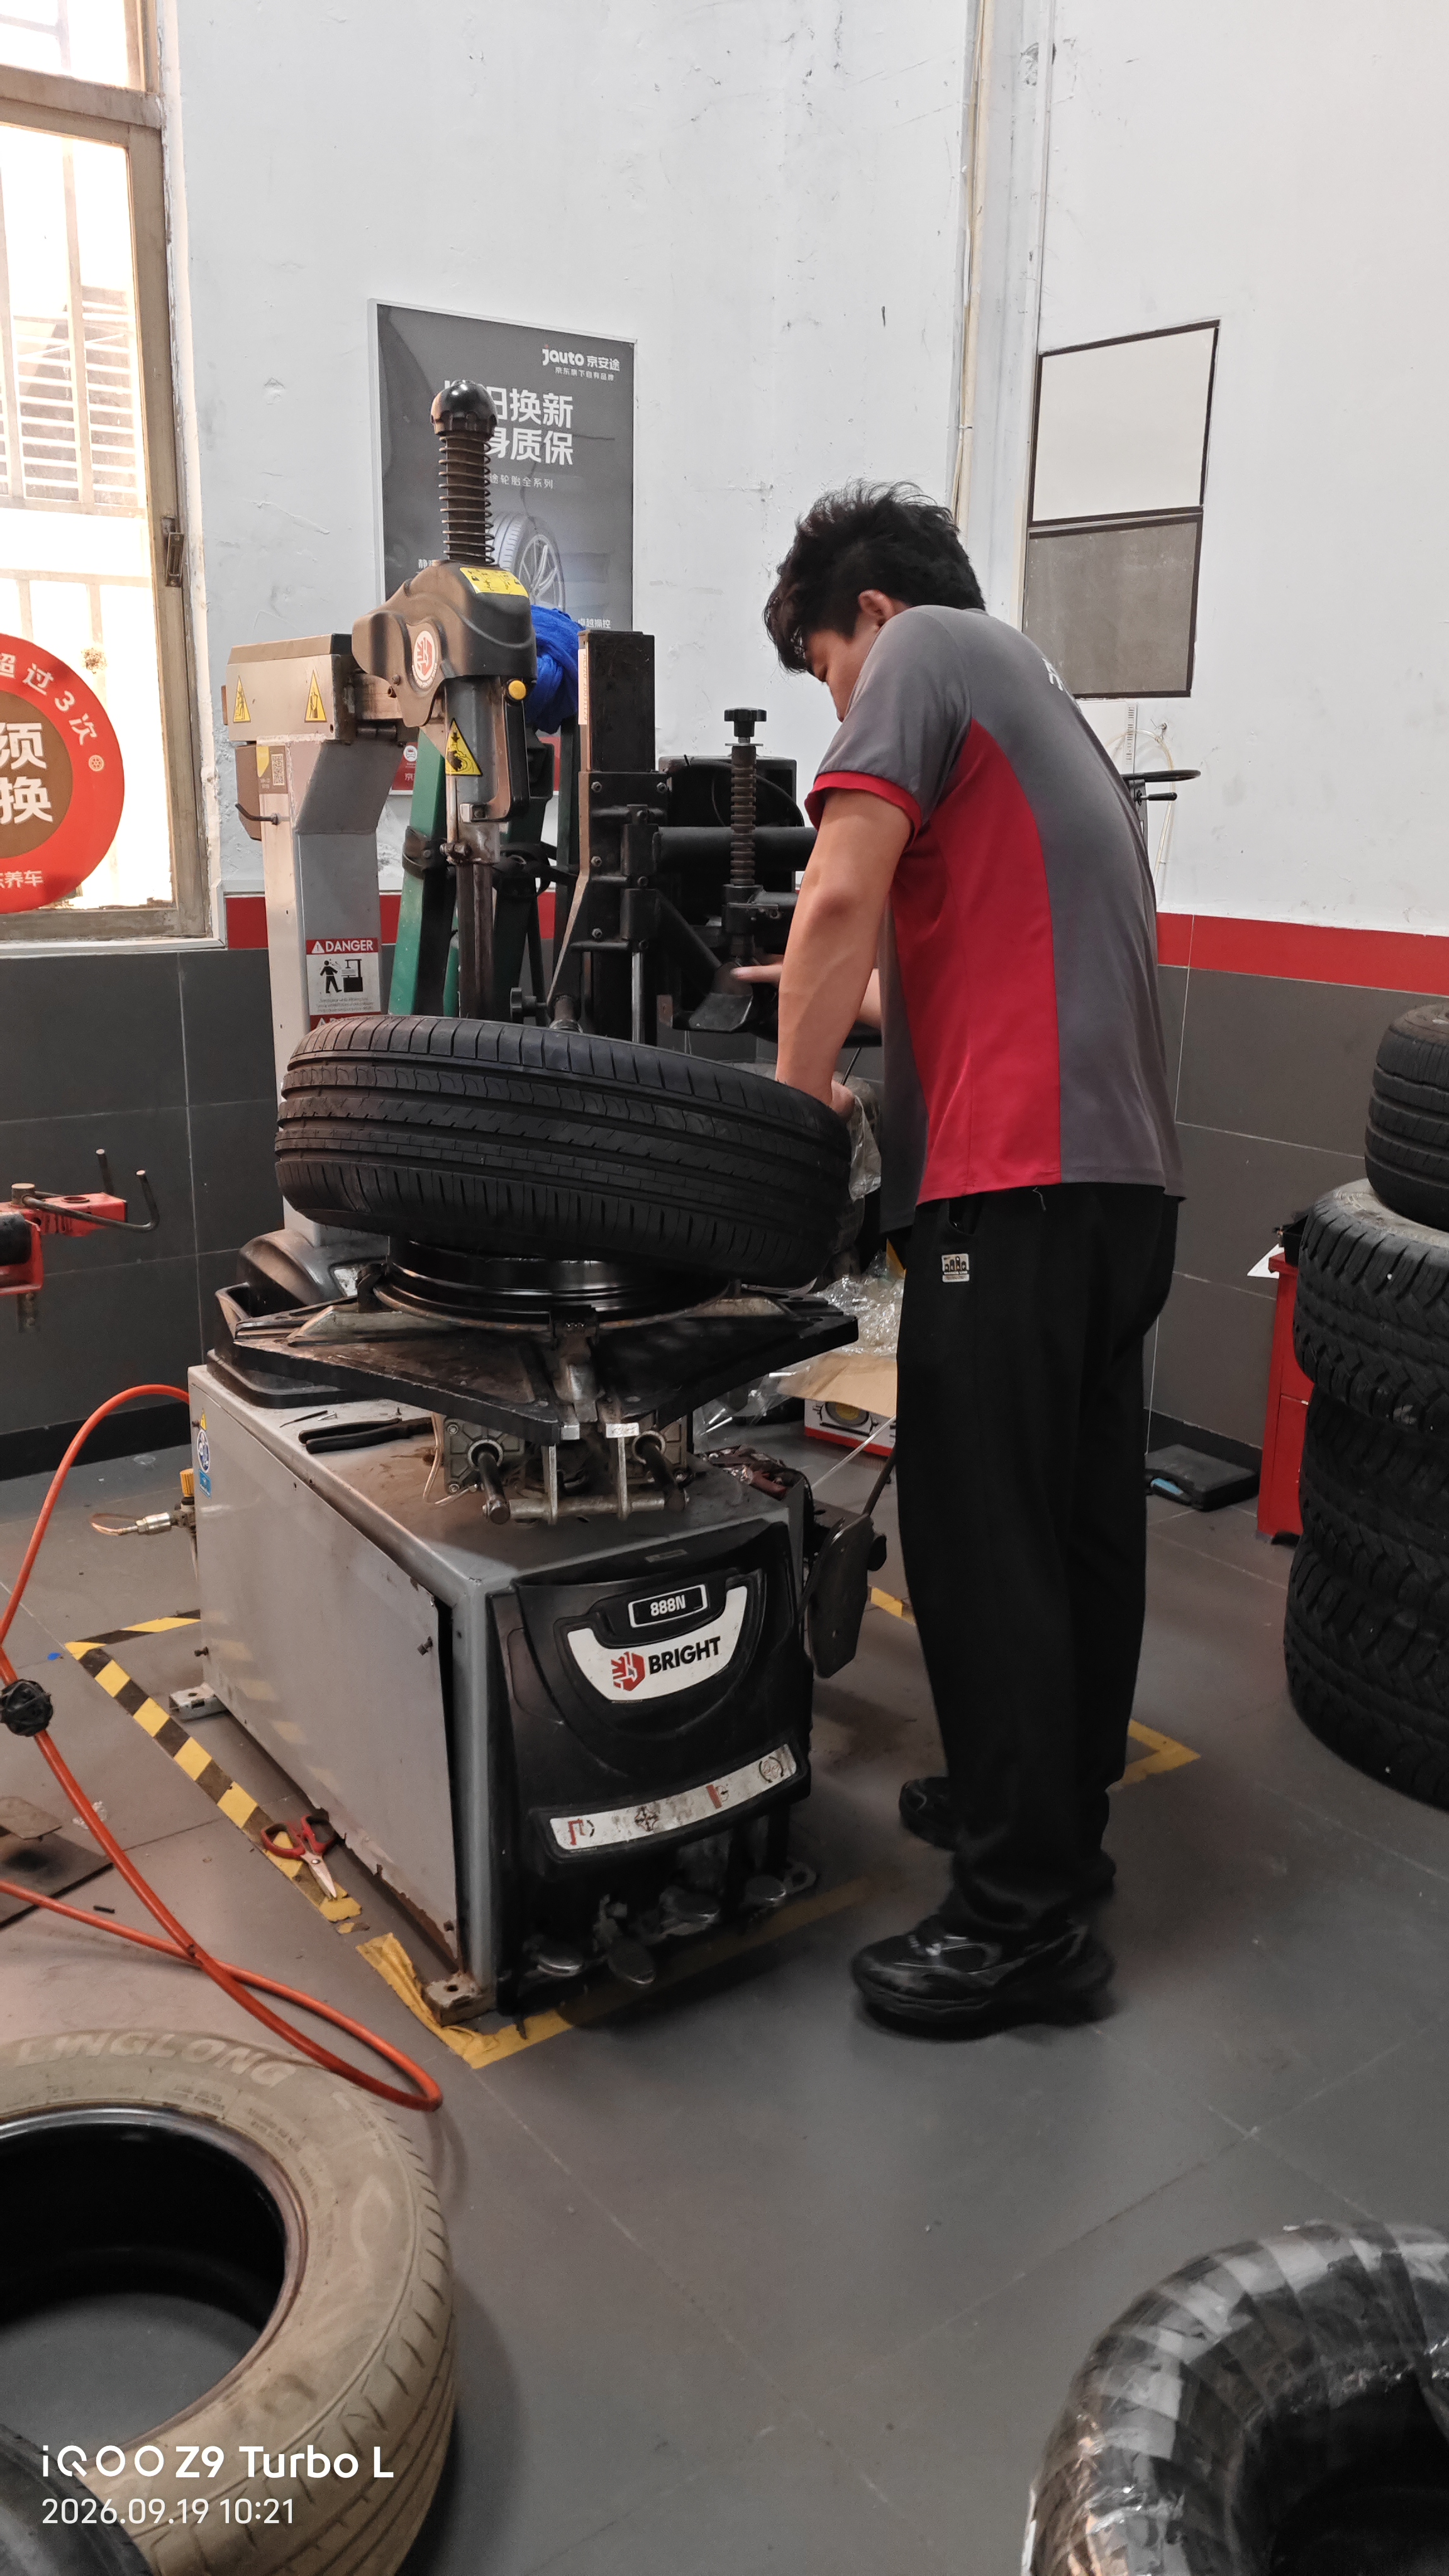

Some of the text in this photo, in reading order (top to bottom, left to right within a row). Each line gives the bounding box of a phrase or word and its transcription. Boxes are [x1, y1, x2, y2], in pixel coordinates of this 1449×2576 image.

[542, 344, 620, 372] jauto 京安途
[0, 870, 43, 888] 养车
[325, 940, 374, 952] DANGER
[650, 1594, 686, 1617] 888N
[648, 1636, 721, 1675] BRIGHT
